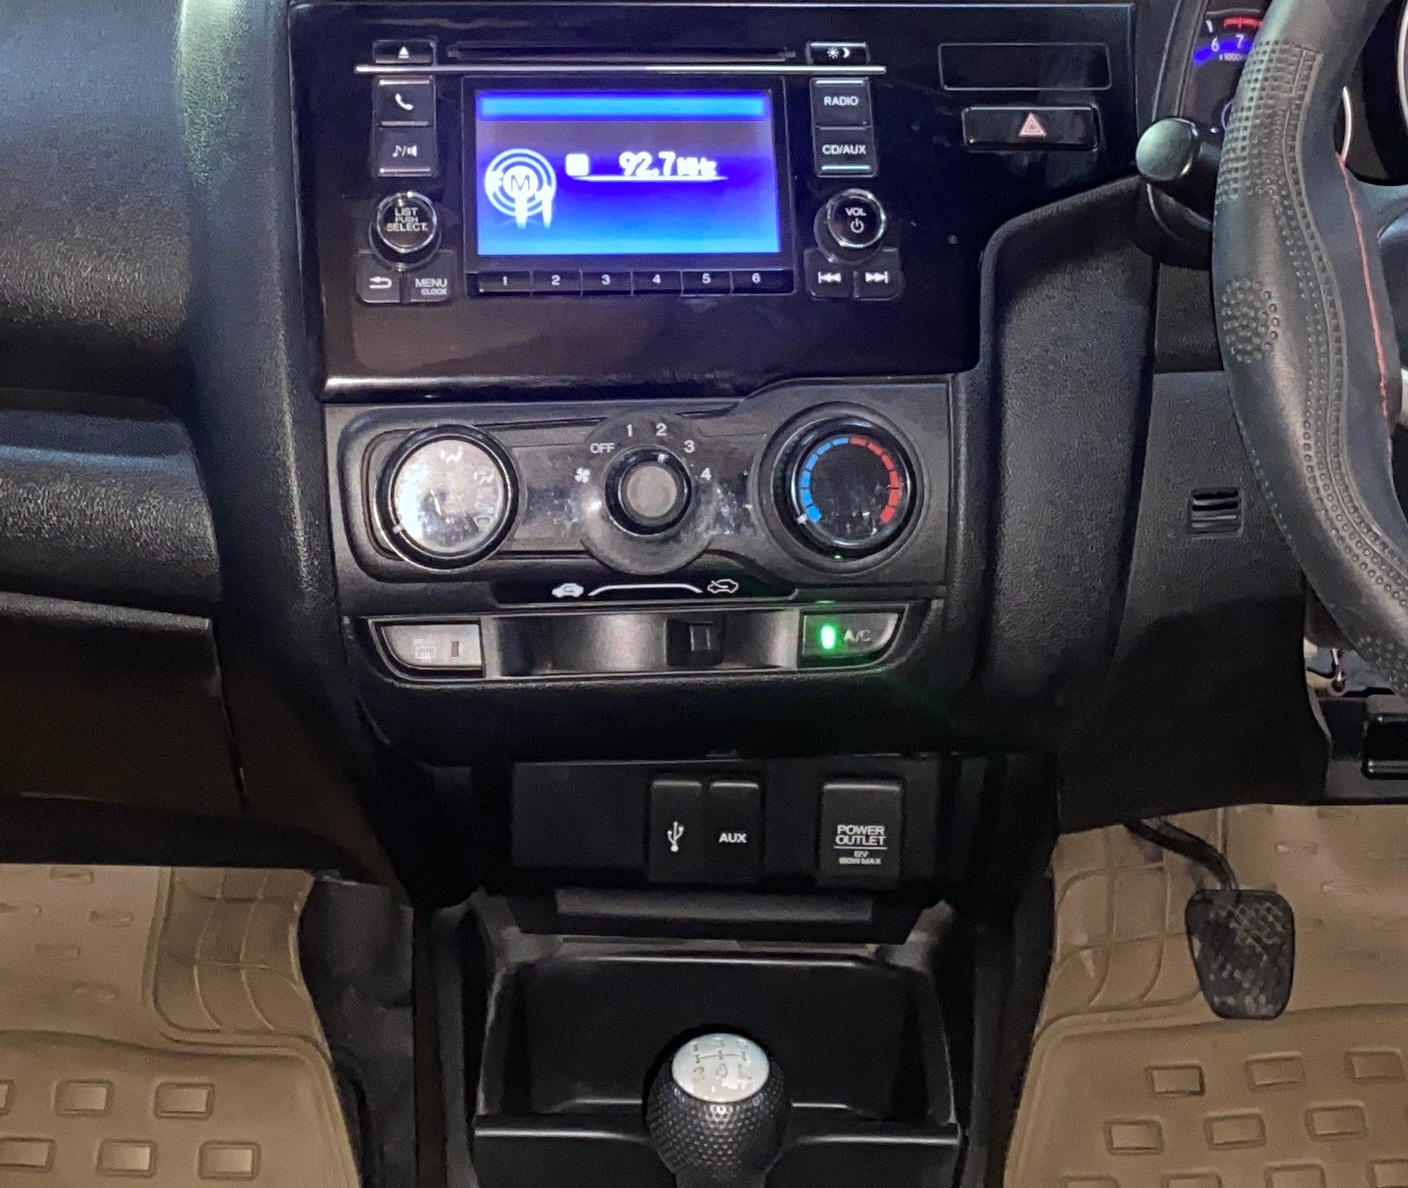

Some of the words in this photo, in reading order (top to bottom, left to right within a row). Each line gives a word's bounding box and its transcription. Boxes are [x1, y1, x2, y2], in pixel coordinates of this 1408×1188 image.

[1211, 37, 1220, 52] 6
[1235, 34, 1245, 49] 7
[824, 96, 859, 106] RADIO
[822, 144, 867, 155] CD/AUX
[394, 207, 419, 216] LIST
[845, 207, 867, 216] VOL
[415, 278, 448, 288] MENU
[502, 275, 508, 286] 1
[551, 275, 561, 286] 2
[601, 274, 611, 285] 3
[652, 274, 662, 284] 4
[702, 273, 711, 284] 5
[751, 273, 761, 283] 6
[626, 423, 633, 437] 1
[655, 422, 667, 436] 2
[590, 443, 615, 453] OFF
[684, 440, 695, 453] 3
[700, 467, 712, 480] 4
[844, 628, 871, 642] A/C
[837, 824, 885, 835] POWER
[718, 833, 747, 843] AUX
[835, 835, 887, 846] OUTLET
